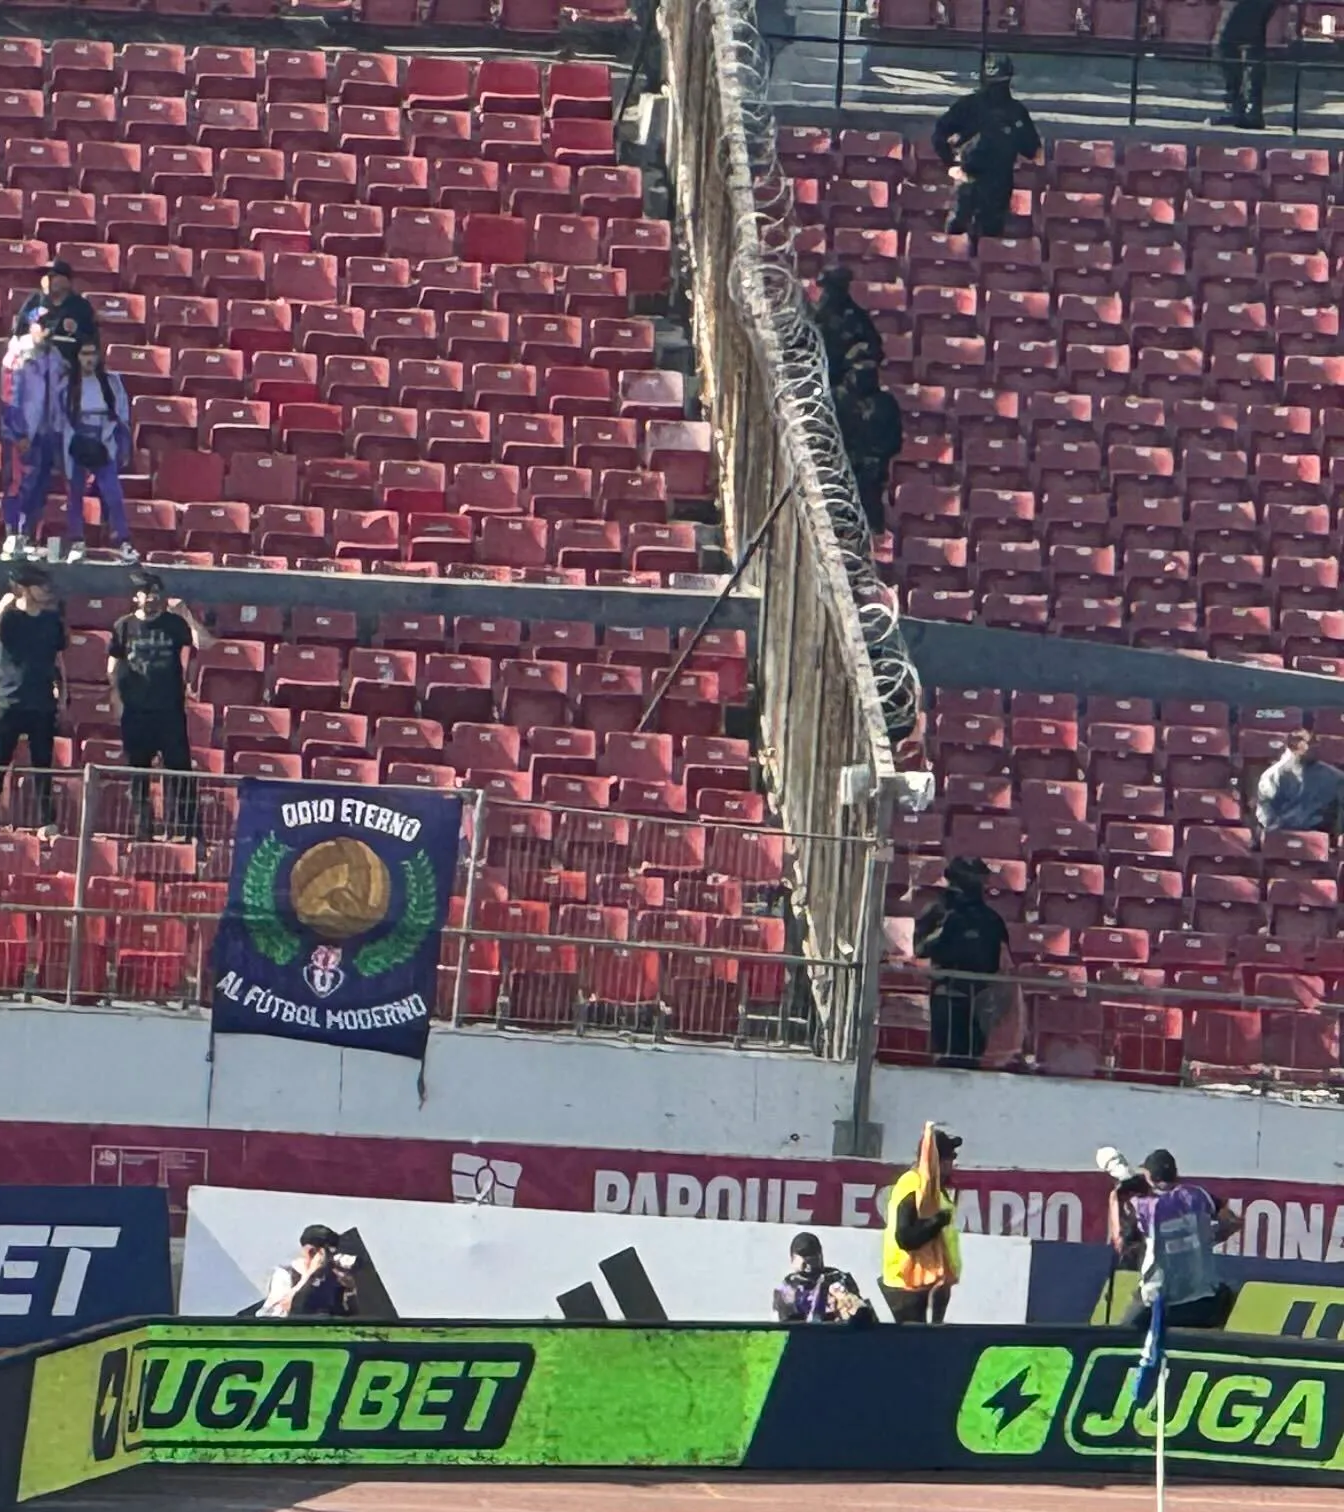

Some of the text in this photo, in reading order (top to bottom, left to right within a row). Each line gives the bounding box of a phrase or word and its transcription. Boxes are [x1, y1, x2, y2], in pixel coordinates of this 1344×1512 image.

[281, 798, 422, 843] ODIO ETERNO
[216, 970, 240, 1001] AL
[325, 992, 428, 1031] MODERNO
